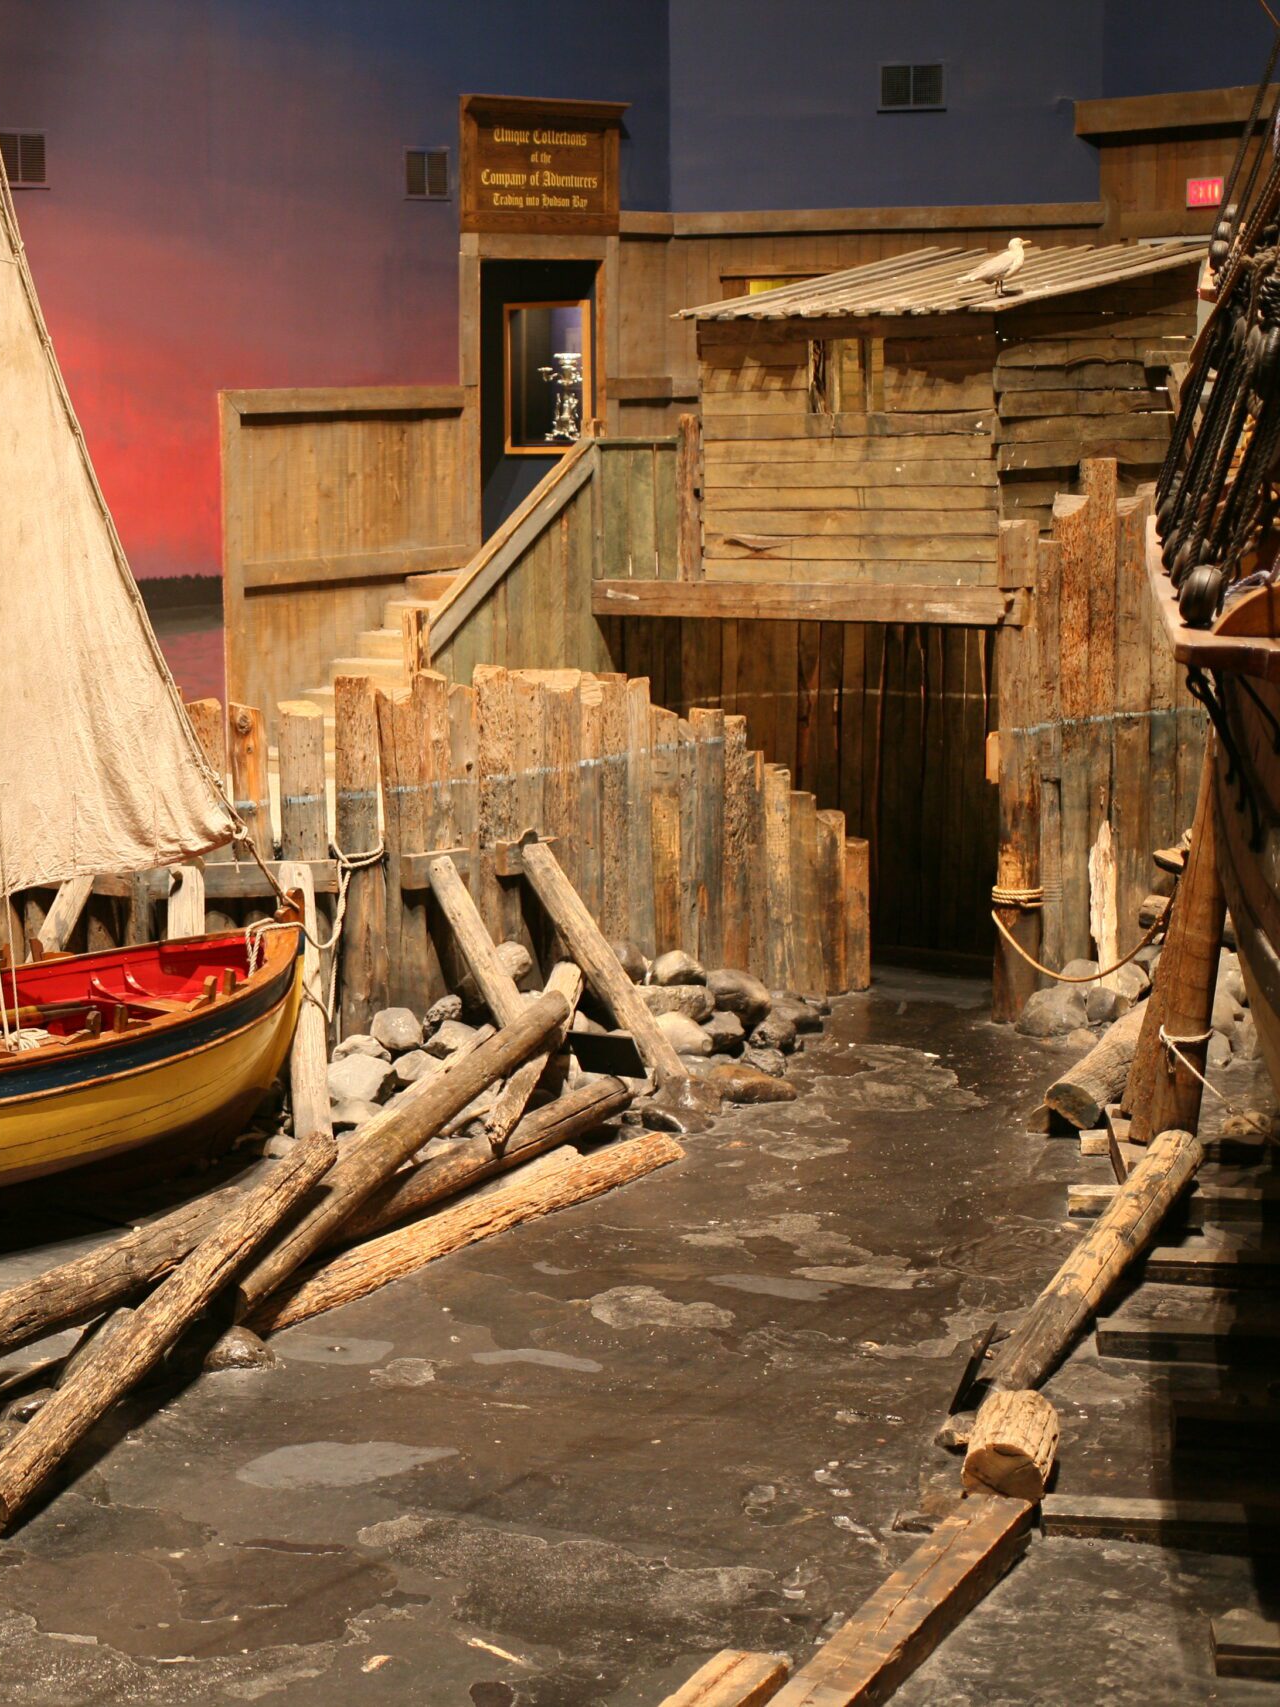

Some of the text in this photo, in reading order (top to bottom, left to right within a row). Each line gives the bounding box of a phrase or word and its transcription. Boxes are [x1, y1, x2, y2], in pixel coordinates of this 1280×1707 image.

[494, 128, 587, 146] Unique Collections
[530, 152, 551, 164] of the
[481, 169, 597, 189] Company of Adventurers
[493, 193, 588, 210] Trading into Hudson Bay
